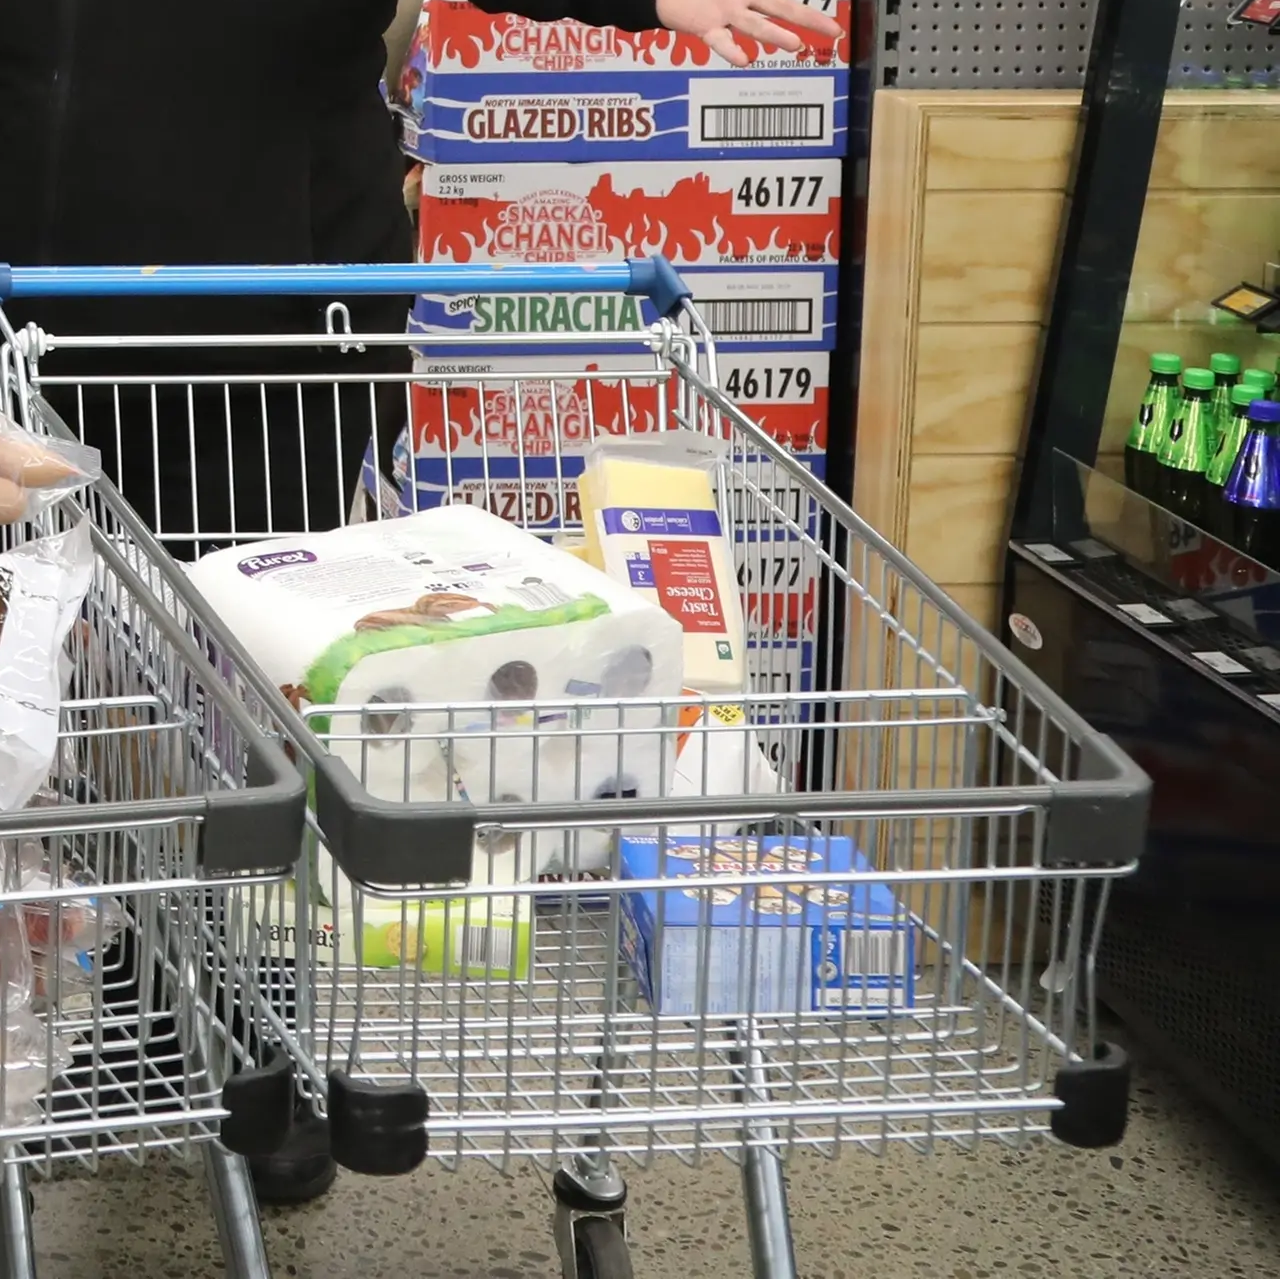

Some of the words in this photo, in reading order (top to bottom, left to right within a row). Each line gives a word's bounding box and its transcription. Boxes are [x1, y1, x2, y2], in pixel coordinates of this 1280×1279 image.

[503, 27, 614, 54] CHANGI
[532, 54, 584, 71] CHIPS
[779, 59, 809, 69] POTATO
[484, 97, 508, 107] NORTH
[509, 97, 571, 107] HIMALAYAN
[467, 107, 577, 140] GLAZED
[586, 107, 652, 138] RIBS
[439, 174, 468, 184] GROSS
[470, 173, 505, 184] WEIGHT:
[439, 186, 452, 196] 2.2
[453, 186, 465, 197] kg
[737, 176, 824, 208] 46177
[533, 198, 572, 206] AMAZING
[508, 206, 594, 223] SNACKA
[497, 224, 607, 251] CHANGI
[524, 251, 577, 263] CHIPS
[719, 254, 754, 265] PACKETS
[756, 254, 767, 264] OF
[768, 254, 800, 264] POTATO
[448, 294, 482, 314] SPICY
[473, 295, 641, 333] SRIRACHA
[726, 367, 812, 399] 46179
[495, 394, 582, 412] SNACKA
[483, 414, 590, 441] CHANGI
[242, 550, 311, 573] Purex
[637, 570, 646, 582] 3
[665, 585, 715, 601] Cheese
[680, 598, 718, 619] Tasty
